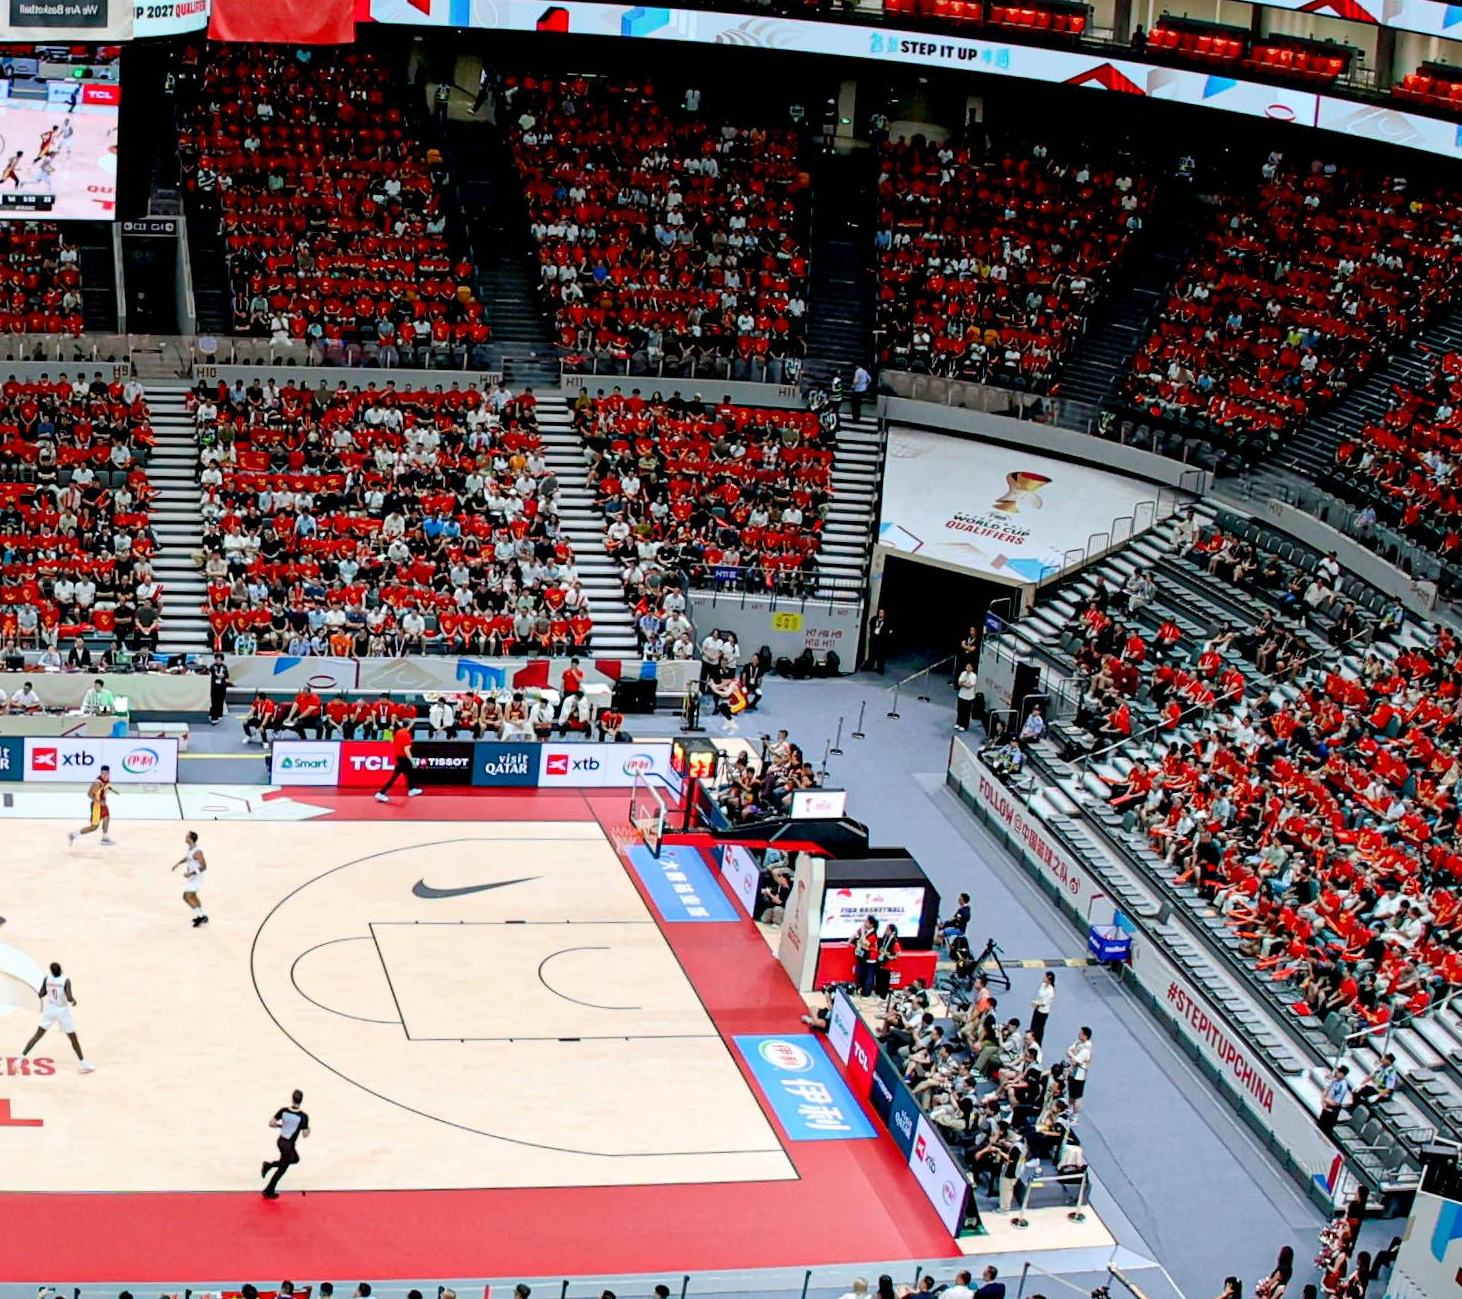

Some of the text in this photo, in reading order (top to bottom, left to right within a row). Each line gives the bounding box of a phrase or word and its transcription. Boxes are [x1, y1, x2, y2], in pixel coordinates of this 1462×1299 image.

[900, 39, 936, 56] STEP
[938, 43, 954, 59] IT
[956, 46, 977, 61] UP
[88, 90, 113, 99] TCL
[112, 364, 128, 376] H9
[196, 366, 217, 378] H10
[479, 373, 499, 386] H10
[565, 377, 584, 388] H11
[778, 387, 798, 398] H11
[953, 512, 1031, 537] WORLD CUP
[945, 519, 1025, 546] QUALIFIERS
[62, 751, 95, 767] xtb
[294, 757, 329, 769] Smart
[350, 755, 394, 771] TCL
[427, 757, 469, 768] TISSOT
[499, 754, 528, 764] visit
[572, 757, 600, 772] xtb
[485, 761, 528, 776] QATAR
[689, 763, 709, 778] 23
[978, 774, 1014, 823] FOLLOW
[840, 906, 905, 914] FIBA BASKETBALL
[1166, 980, 1275, 1116] #STEPITUPCHINA
[854, 1040, 869, 1072] TCL
[780, 1077, 852, 1131] 伊利
